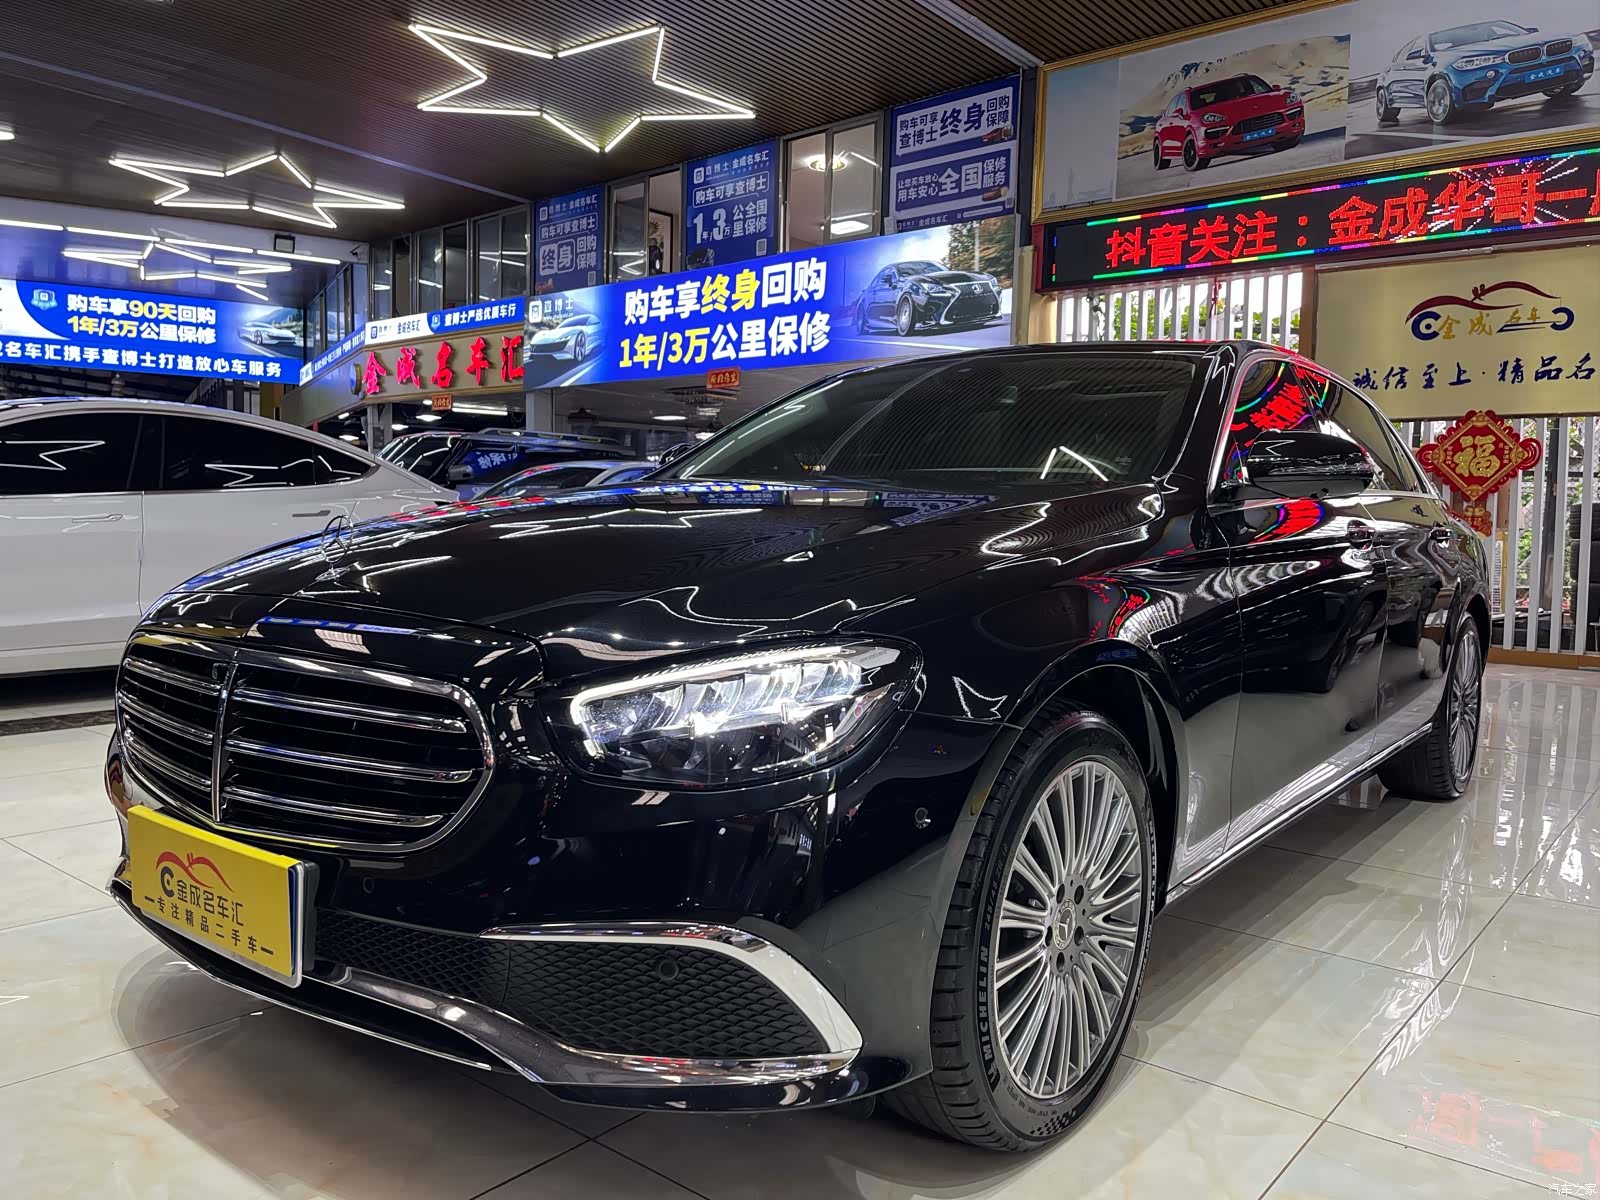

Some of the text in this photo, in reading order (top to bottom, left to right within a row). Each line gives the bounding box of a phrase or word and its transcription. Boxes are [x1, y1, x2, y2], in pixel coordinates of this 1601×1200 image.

[987, 95, 1009, 112] 回购
[899, 112, 939, 132] 购车可享
[940, 102, 986, 138] 终身
[986, 110, 1009, 127] 保障
[899, 127, 938, 149] 查博士
[983, 156, 1007, 174] 保修
[695, 175, 767, 204] 购车可享查博士
[897, 183, 939, 203] 用车安心
[938, 162, 983, 197] 全国
[983, 171, 1006, 188] 服务
[541, 215, 596, 239] 购车可享查博士
[541, 244, 573, 271] 终身
[577, 234, 597, 254] 回购
[625, 257, 827, 325] 购车享终身回购
[67, 294, 217, 325] 购车享90天回购
[444, 303, 517, 327] 查博士严选优质车行
[67, 315, 217, 345] 1年/3万公里保修
[619, 311, 831, 371] 1年/3万公里保修
[1453, 435, 1501, 478] 福
[177, 879, 244, 927] 金成名车汇
[979, 945, 993, 1061] MICHELIN
